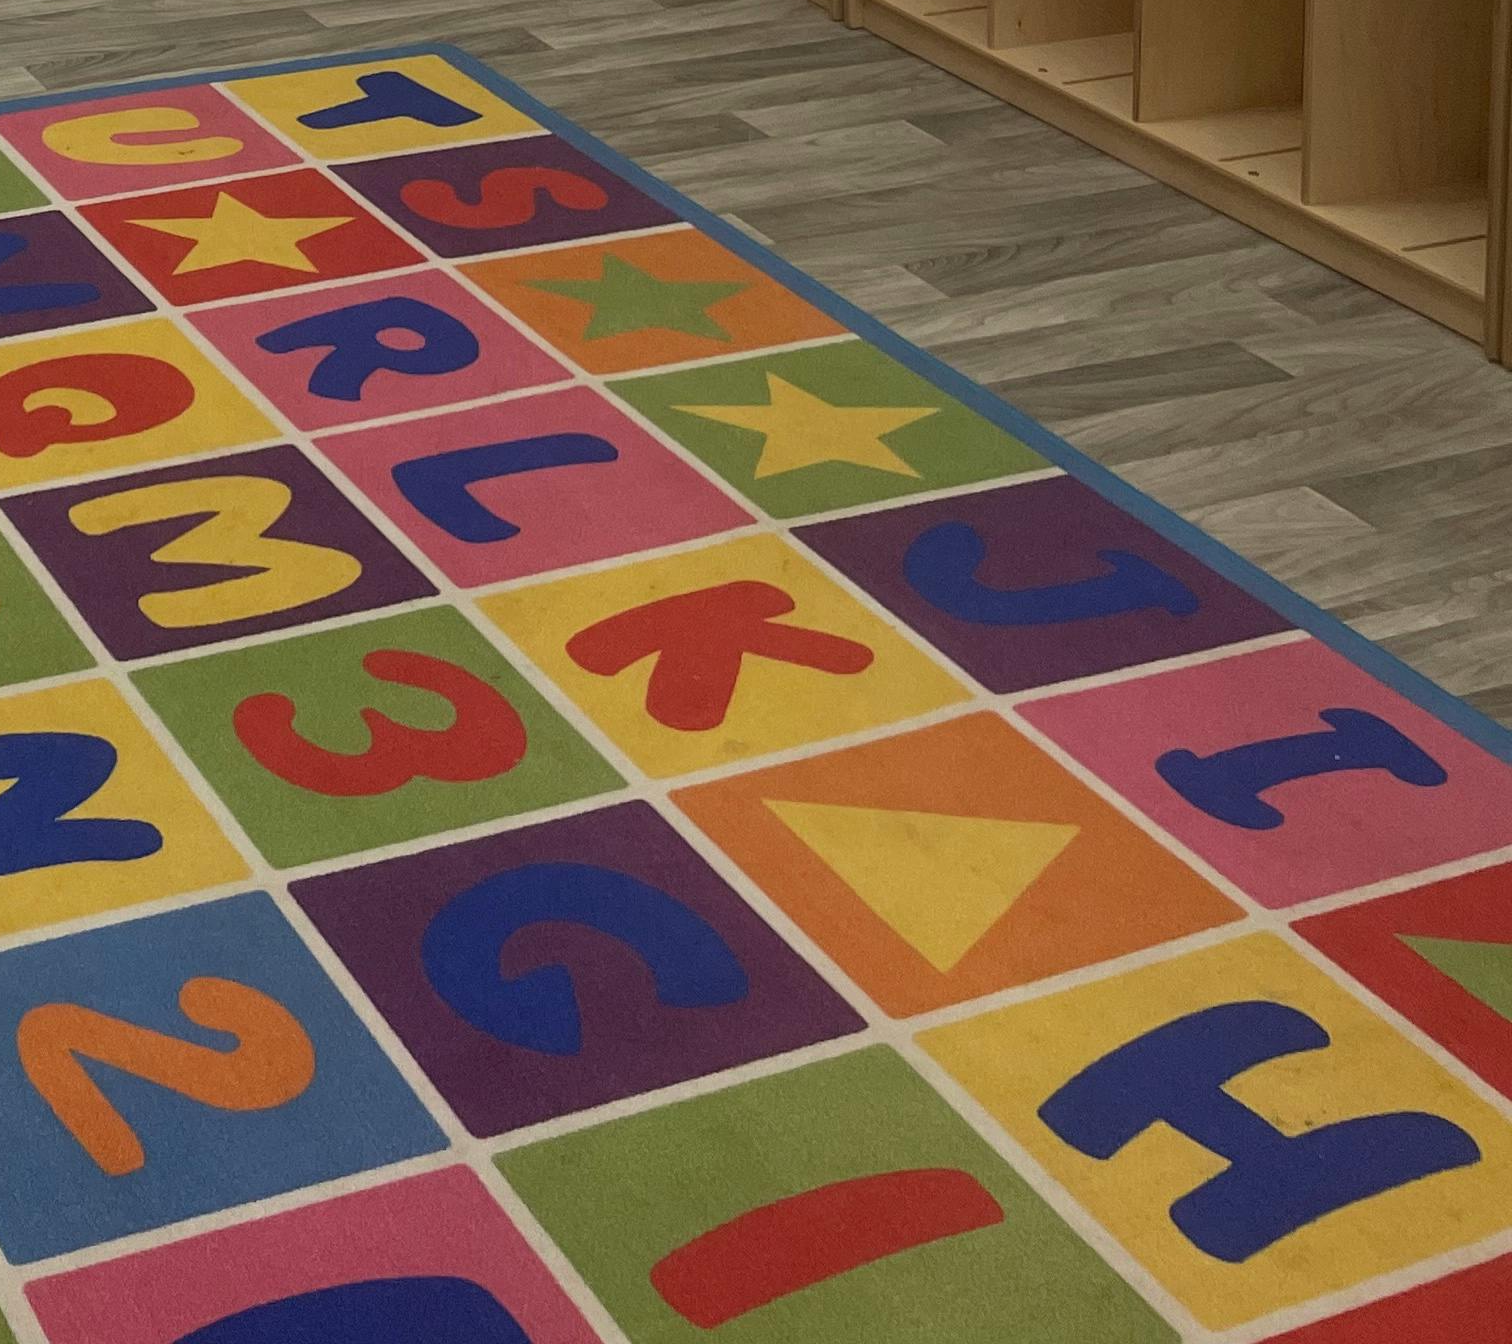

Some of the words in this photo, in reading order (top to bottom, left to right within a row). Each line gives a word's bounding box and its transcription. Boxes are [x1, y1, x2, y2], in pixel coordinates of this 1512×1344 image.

[43, 107, 240, 164] U
[295, 69, 485, 129] T
[402, 168, 606, 228] S
[260, 297, 478, 401] R
[393, 434, 615, 543] L
[70, 477, 360, 627] M
[901, 519, 1203, 629] J
[566, 581, 873, 731] K
[235, 651, 526, 795] 3
[1156, 708, 1446, 830] I
[420, 863, 748, 1057] G
[20, 979, 312, 1172] 2
[1036, 1000, 1483, 1264] H
